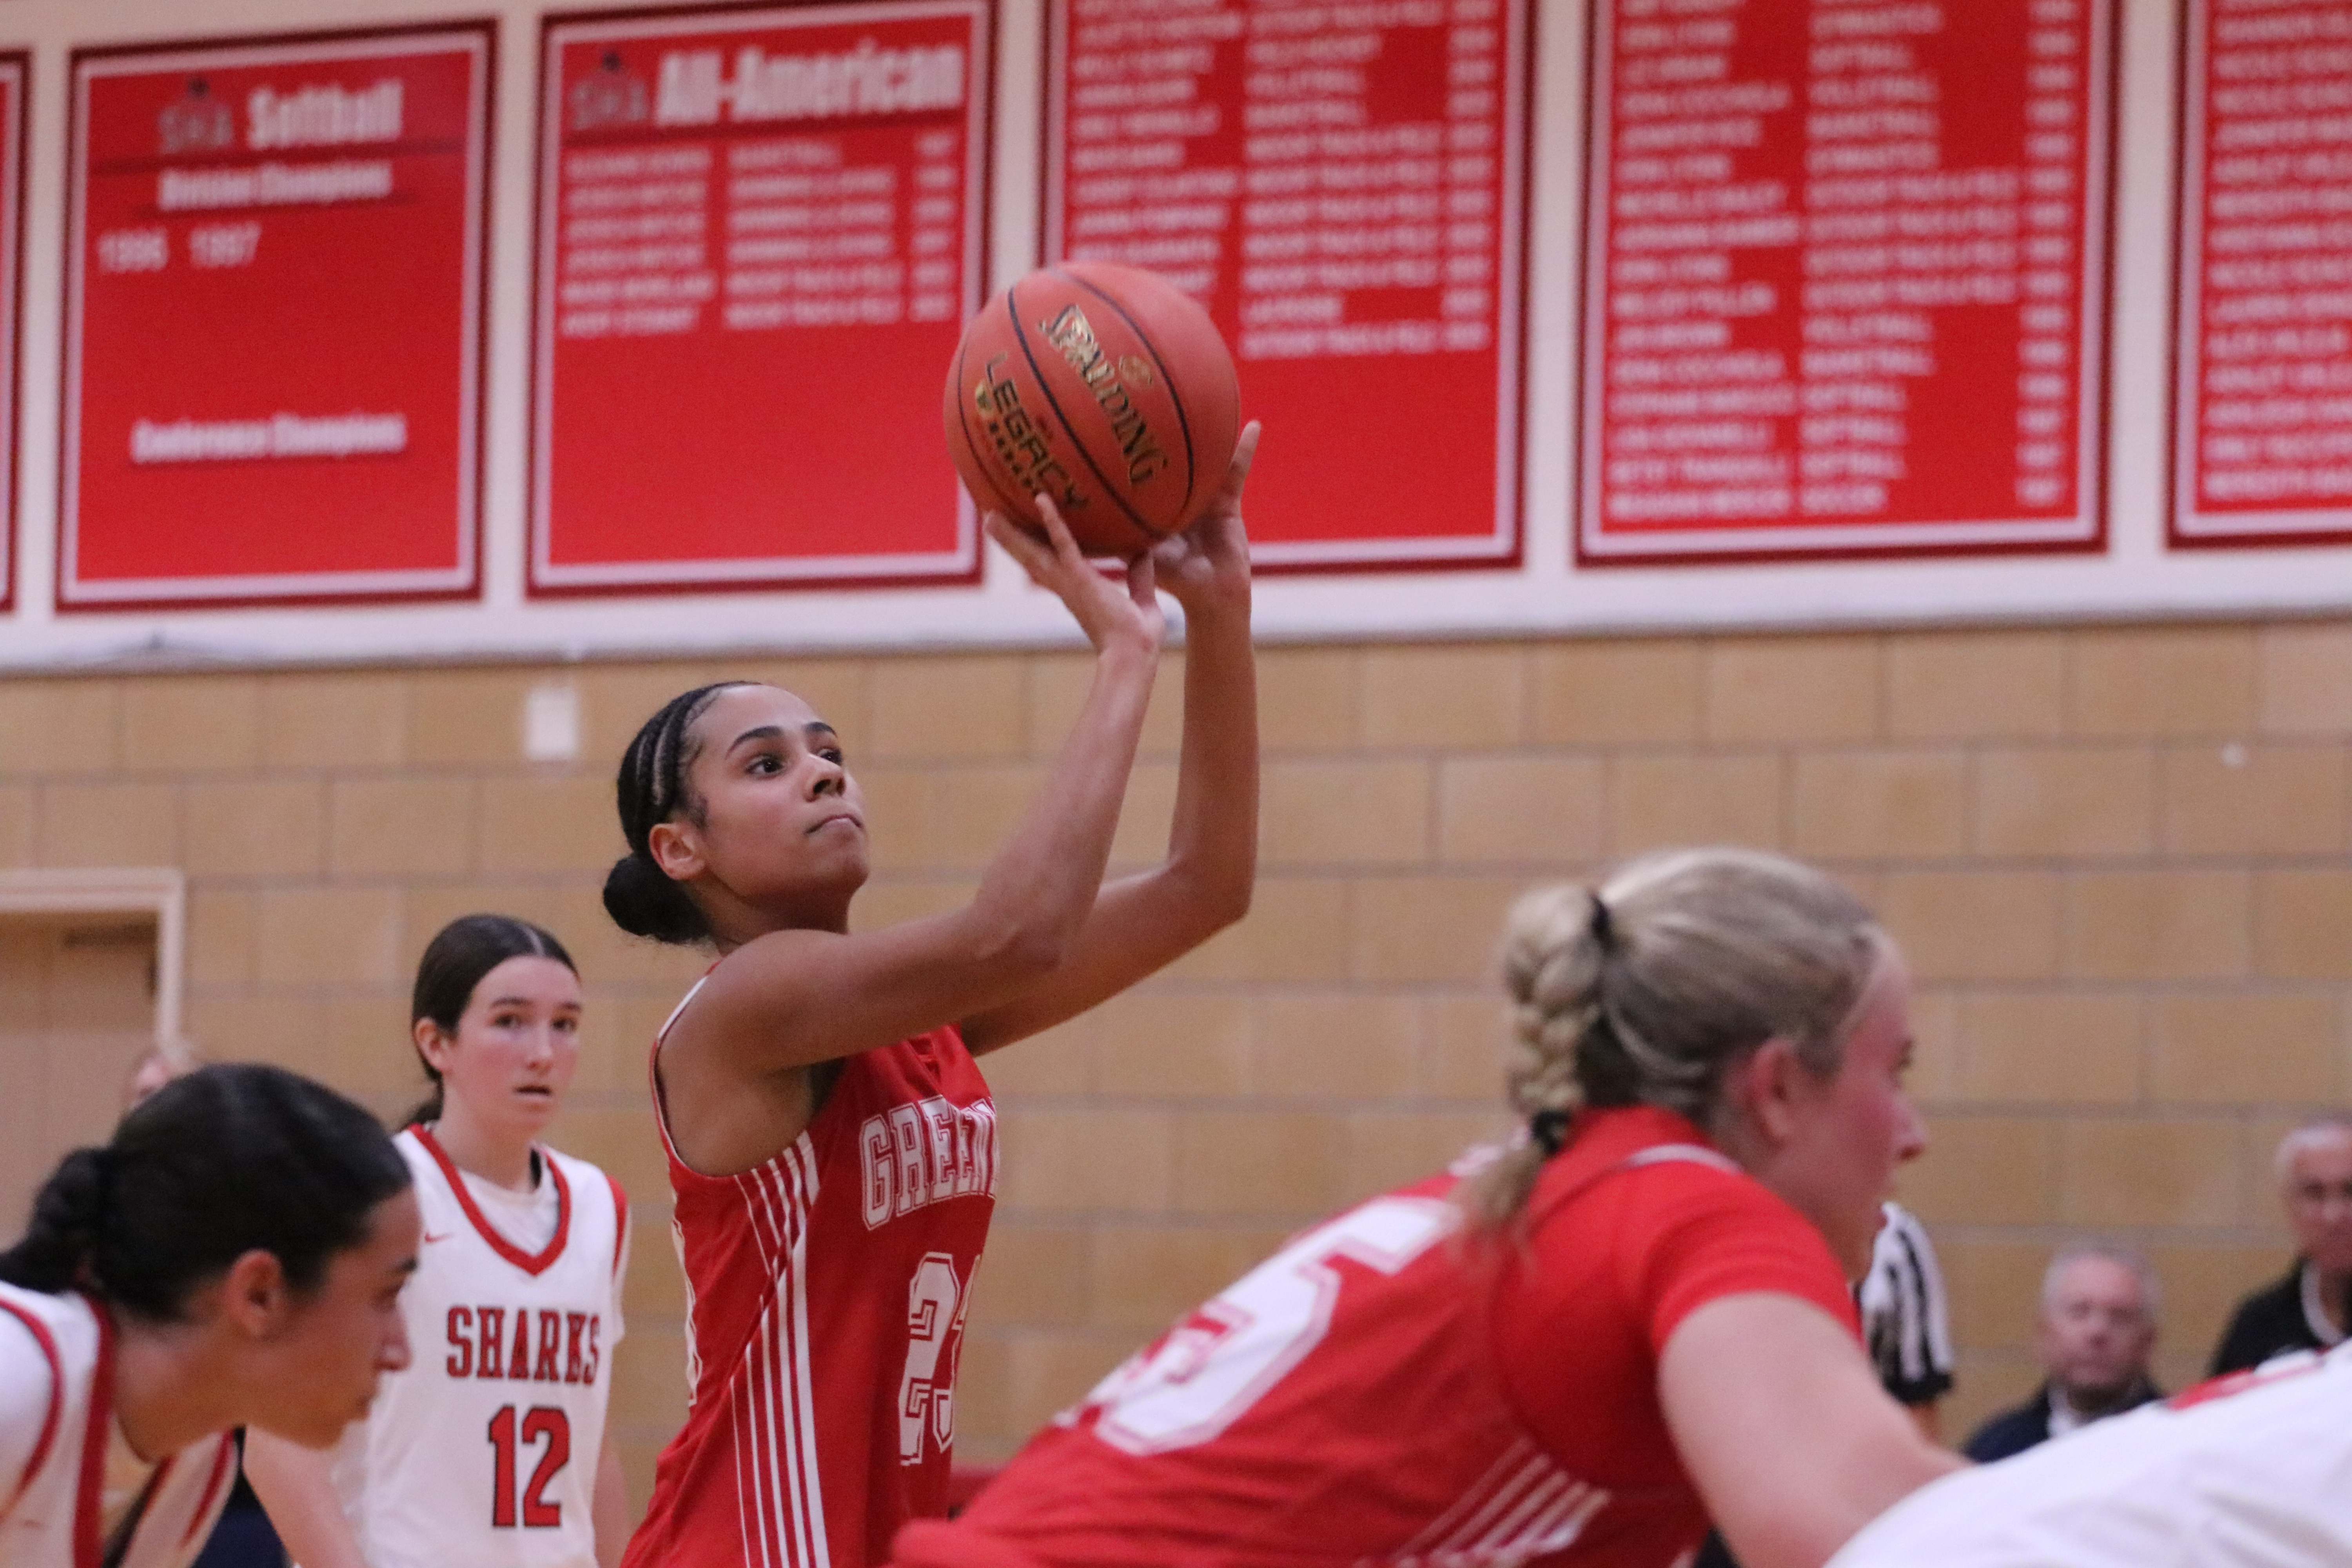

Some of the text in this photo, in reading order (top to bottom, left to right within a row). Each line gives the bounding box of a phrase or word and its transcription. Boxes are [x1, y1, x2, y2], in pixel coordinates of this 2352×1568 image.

[985, 352, 1091, 508] LEGACY
[1038, 304, 1169, 485] SPALDING
[446, 1305, 600, 1385] SHARKS
[488, 1404, 570, 1527] 12
